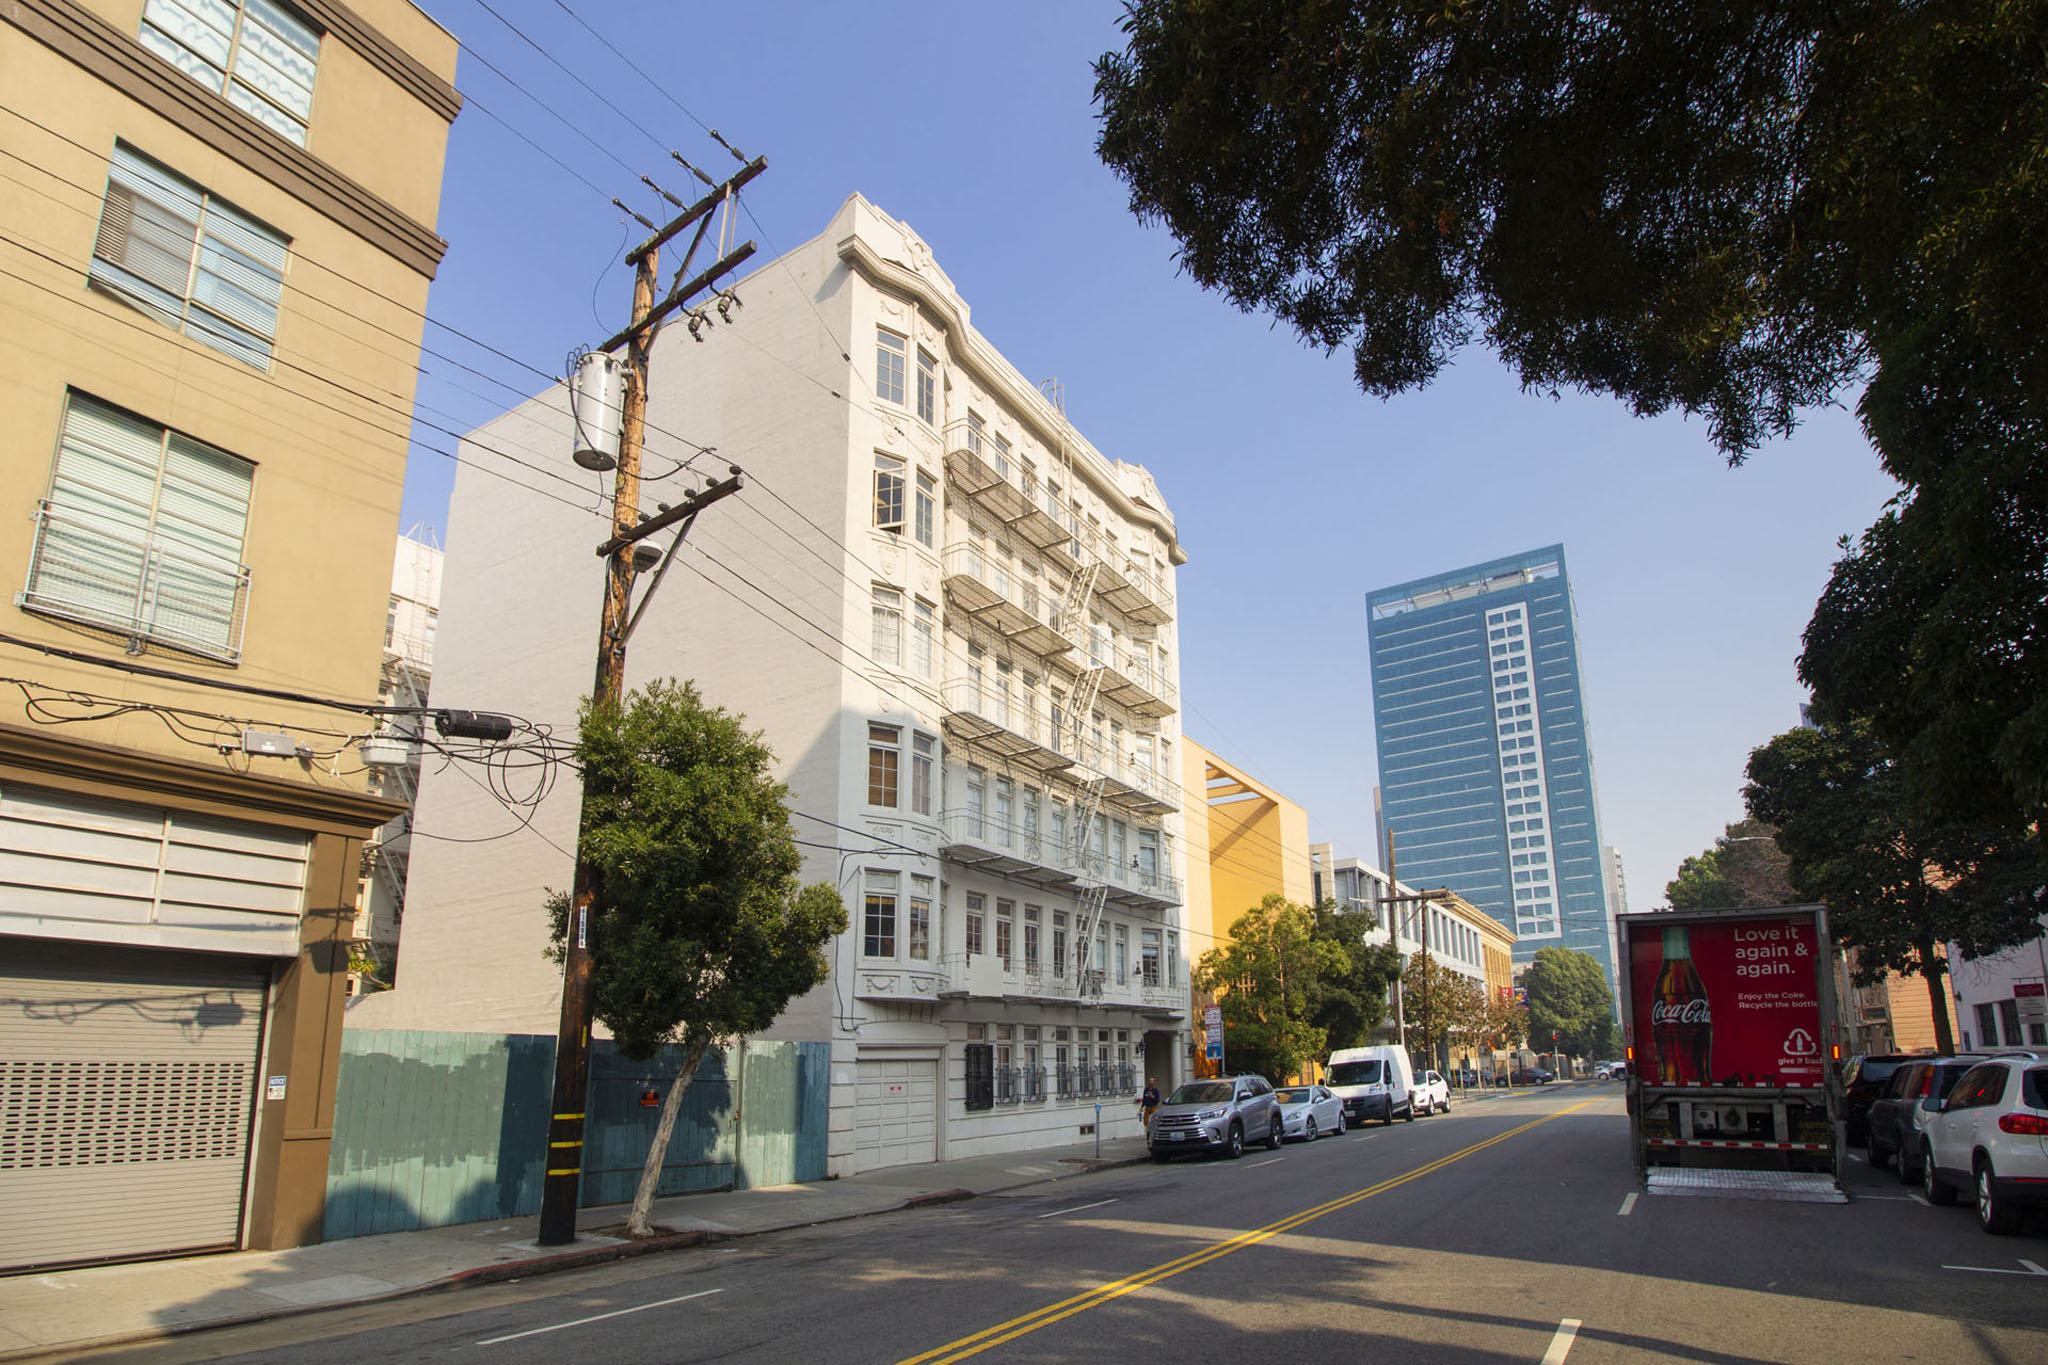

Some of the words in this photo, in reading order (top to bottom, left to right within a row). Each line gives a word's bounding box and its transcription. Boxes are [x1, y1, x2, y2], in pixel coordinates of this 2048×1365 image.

[1734, 928, 1780, 942] Love
[1785, 925, 1799, 940] it
[1735, 943, 1789, 961] again
[1794, 942, 1809, 957] &
[1736, 960, 1796, 978] again.
[1738, 993, 1762, 1001] Enjoy
[1738, 1001, 1773, 1009] Recycle
[1778, 1057, 1795, 1066] give
